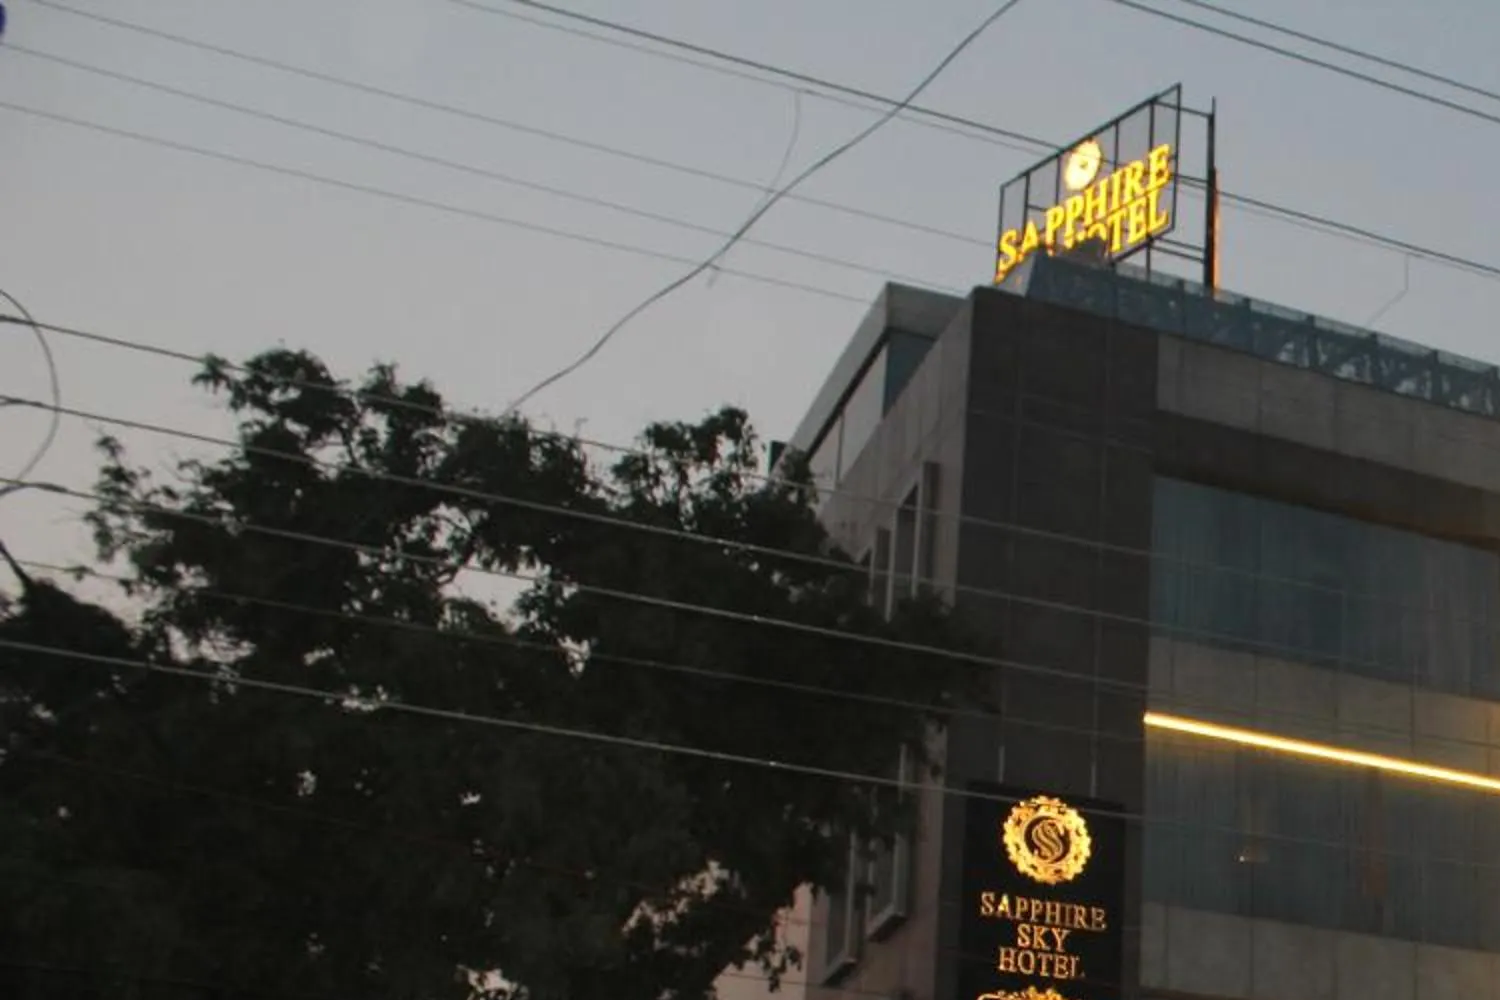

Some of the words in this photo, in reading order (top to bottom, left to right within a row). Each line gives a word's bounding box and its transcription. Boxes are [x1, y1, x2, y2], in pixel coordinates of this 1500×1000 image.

[995, 143, 1171, 283] SAPPHIRE
[980, 892, 1106, 931] SAPPHIRE
[1016, 924, 1071, 951] SKY
[998, 947, 1086, 979] HOTEL
